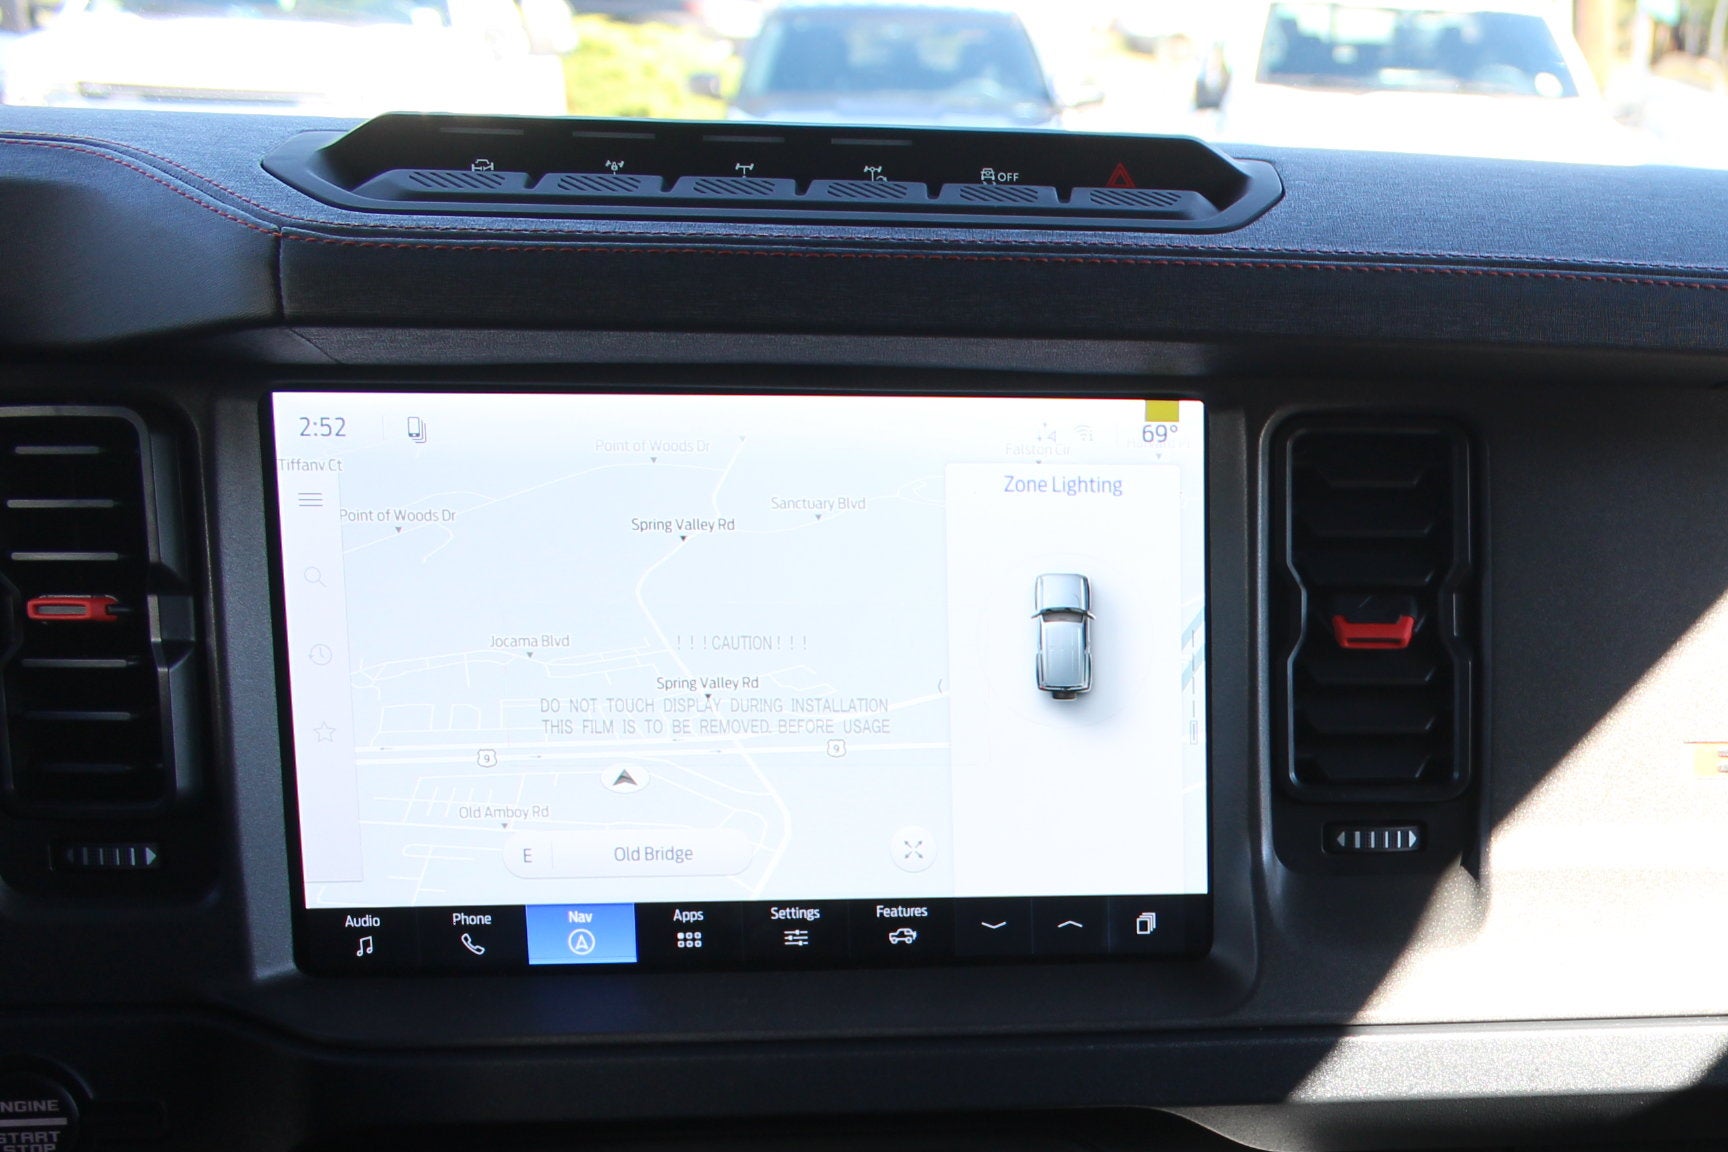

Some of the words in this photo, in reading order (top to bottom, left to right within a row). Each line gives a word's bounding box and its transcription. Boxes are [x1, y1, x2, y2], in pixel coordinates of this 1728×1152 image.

[997, 172, 1020, 182] OFF
[299, 416, 347, 437] 2:52
[595, 439, 630, 452] Point
[633, 439, 648, 452] of
[649, 439, 693, 452] Woods
[696, 440, 711, 452] Dr
[328, 458, 344, 472] Ct
[1004, 475, 1048, 493] Zone
[1052, 475, 1123, 496] Lighting
[771, 496, 835, 511] Sanctuary
[838, 496, 866, 510] Blvd
[340, 508, 374, 521] Point
[377, 508, 391, 521] of
[394, 508, 439, 522] Woods
[442, 508, 456, 521] Dr
[631, 517, 673, 533] Spring
[675, 517, 715, 532] Valley
[718, 517, 736, 531] Rd
[490, 634, 539, 648] Jocama
[541, 634, 571, 648] Blvd
[656, 677, 697, 691] Spring
[700, 676, 739, 690] Valley
[742, 677, 760, 689] Rd
[540, 698, 561, 713] DO
[569, 698, 598, 713] NOT
[606, 698, 655, 713] TOUCH
[664, 698, 720, 713] DISPLAY
[730, 698, 783, 713] DURING
[791, 698, 889, 713] INSTALLATION
[542, 719, 574, 734] THIS
[582, 719, 614, 734] FILM
[623, 719, 636, 734] IS
[644, 719, 663, 734] TO
[672, 719, 692, 734] BE
[778, 719, 835, 734] BEFORE
[843, 719, 891, 734] USAGE
[459, 806, 482, 819] Old
[484, 806, 530, 821] Amboy
[533, 805, 550, 818] Rd
[523, 848, 533, 863] E
[614, 846, 640, 862] Old
[645, 846, 694, 864] Bridge
[452, 911, 492, 926] Phone
[568, 910, 593, 924] Nav
[673, 908, 704, 923] Apps
[770, 906, 821, 921] Settings
[876, 904, 928, 919] Features
[345, 913, 381, 928] Audio
